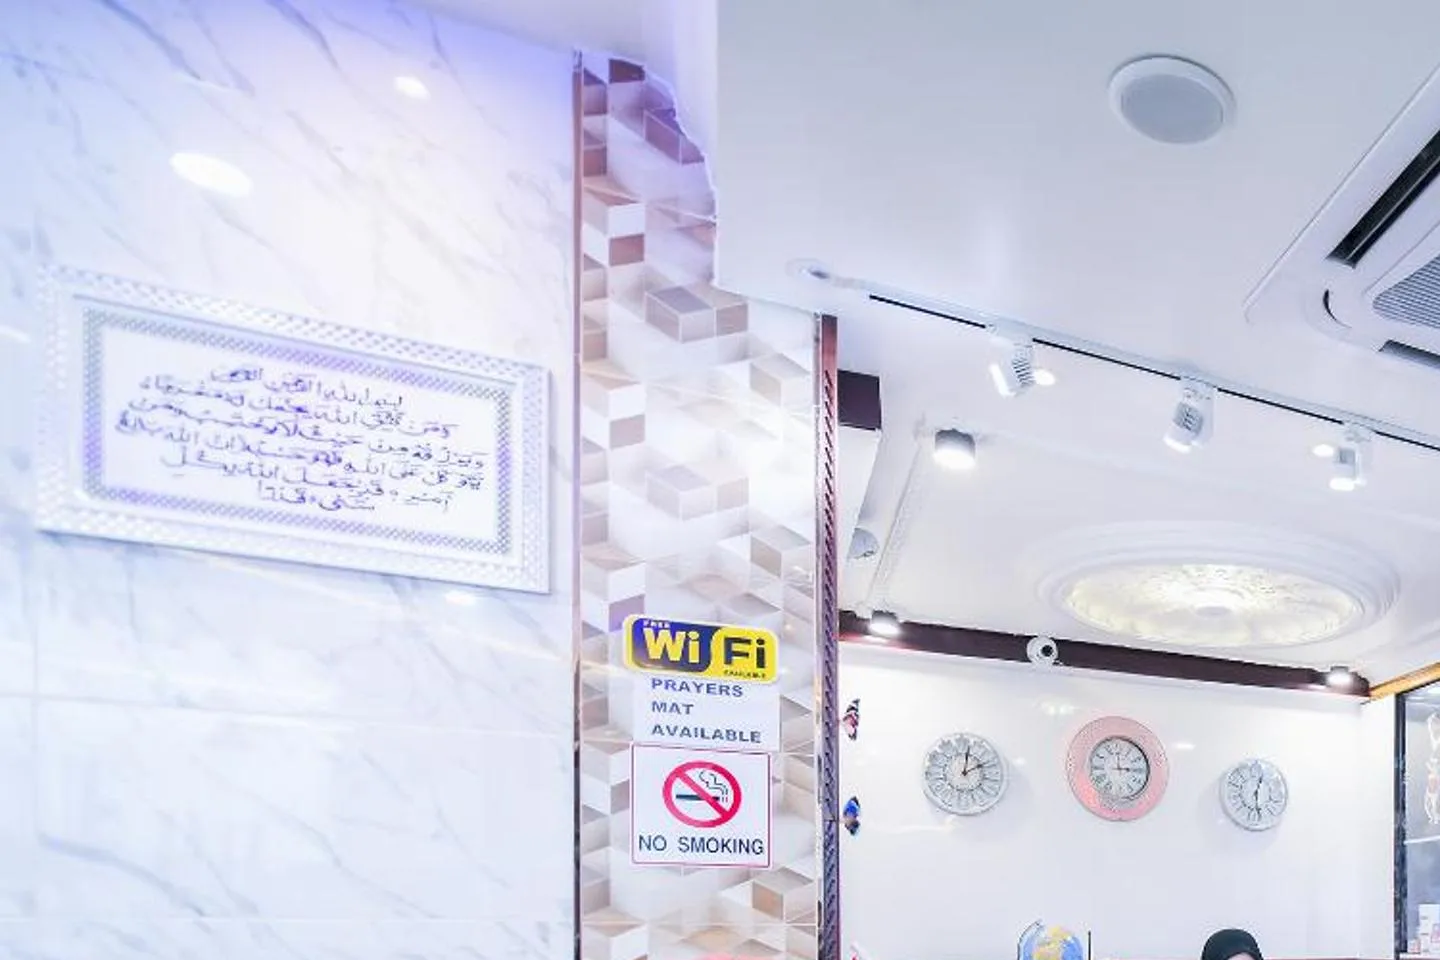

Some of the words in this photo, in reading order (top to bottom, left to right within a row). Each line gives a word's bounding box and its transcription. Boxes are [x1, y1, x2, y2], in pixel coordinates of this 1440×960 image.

[643, 628, 700, 664] Wi
[723, 636, 767, 669] Fi
[651, 677, 744, 698] PRAYERS
[651, 700, 695, 716] MAT
[651, 724, 762, 744] AVAILABLE
[638, 834, 668, 853] NO
[677, 836, 765, 856] SMOKING
